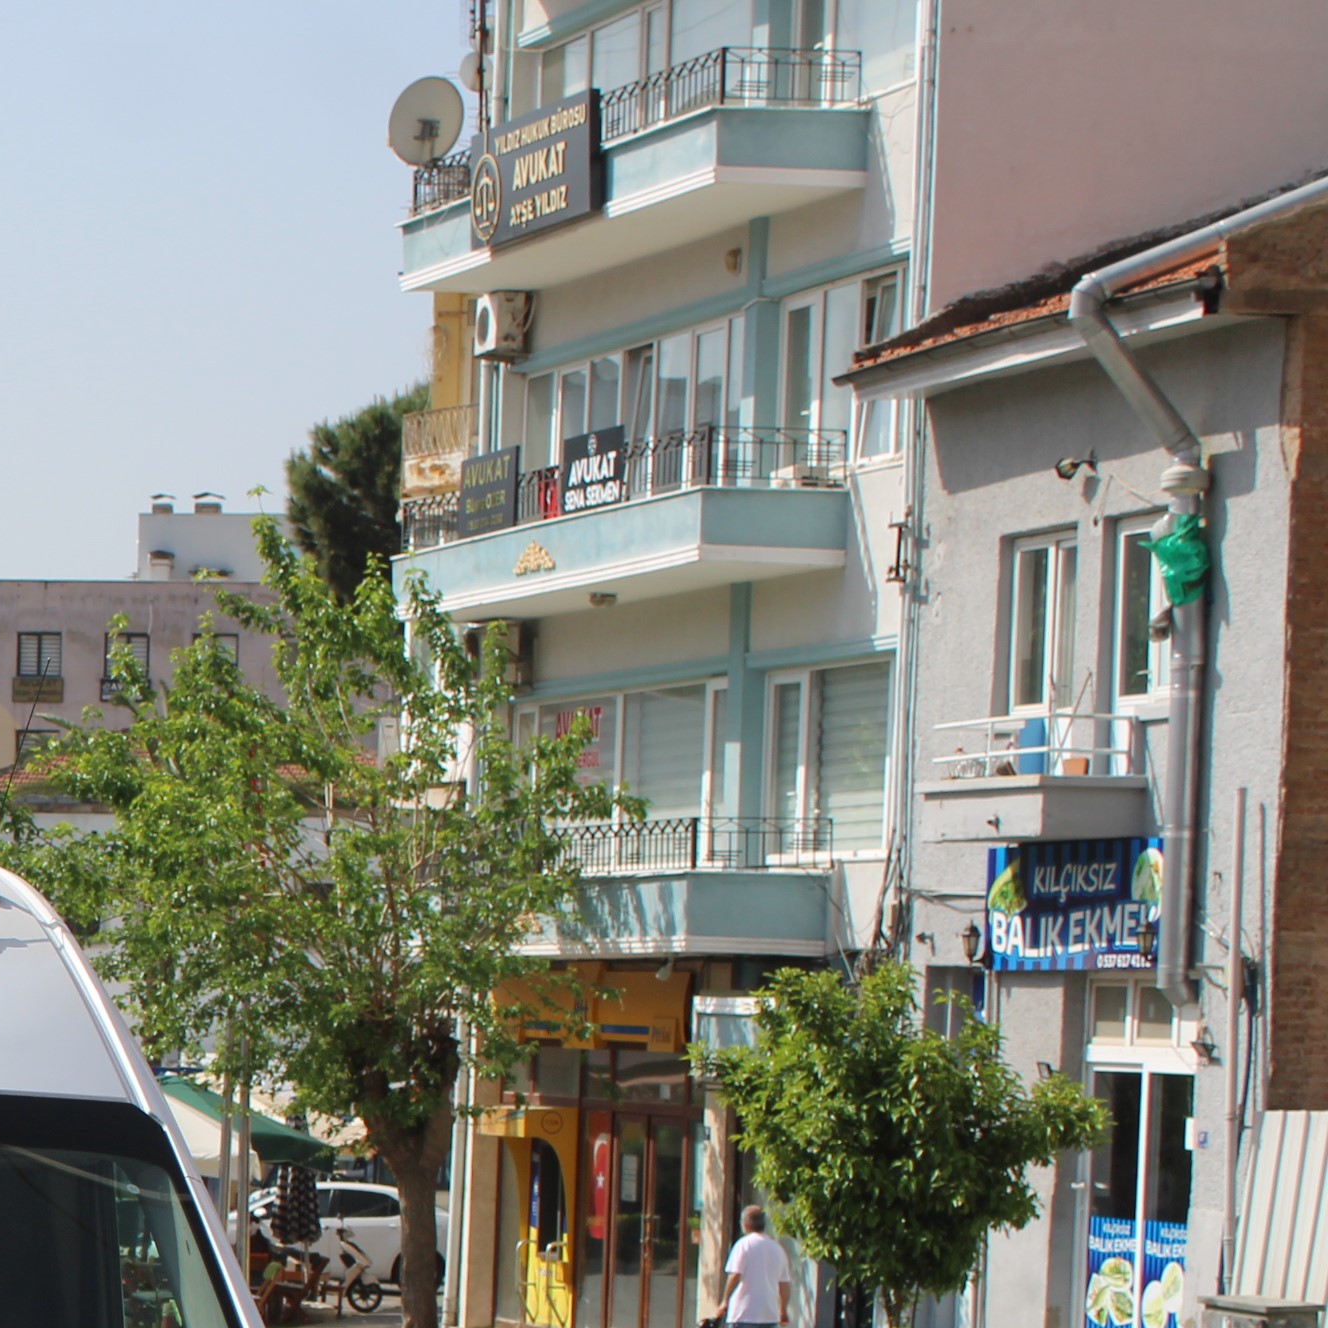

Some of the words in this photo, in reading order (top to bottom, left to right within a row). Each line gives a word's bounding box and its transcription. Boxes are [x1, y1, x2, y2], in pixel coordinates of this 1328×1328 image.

[495, 129, 521, 156] YILDIZ
[521, 117, 550, 147] HUKUK
[550, 103, 587, 134] BÜROSU
[512, 140, 567, 191] AVUKAT
[509, 198, 535, 228] AYŞE
[535, 184, 568, 218] YILDIZ
[464, 455, 511, 489] AVUKAT
[568, 451, 617, 487] AVUKAT
[1033, 863, 1118, 903] KILÇIKSIZ
[992, 910, 1064, 958] BALIK
